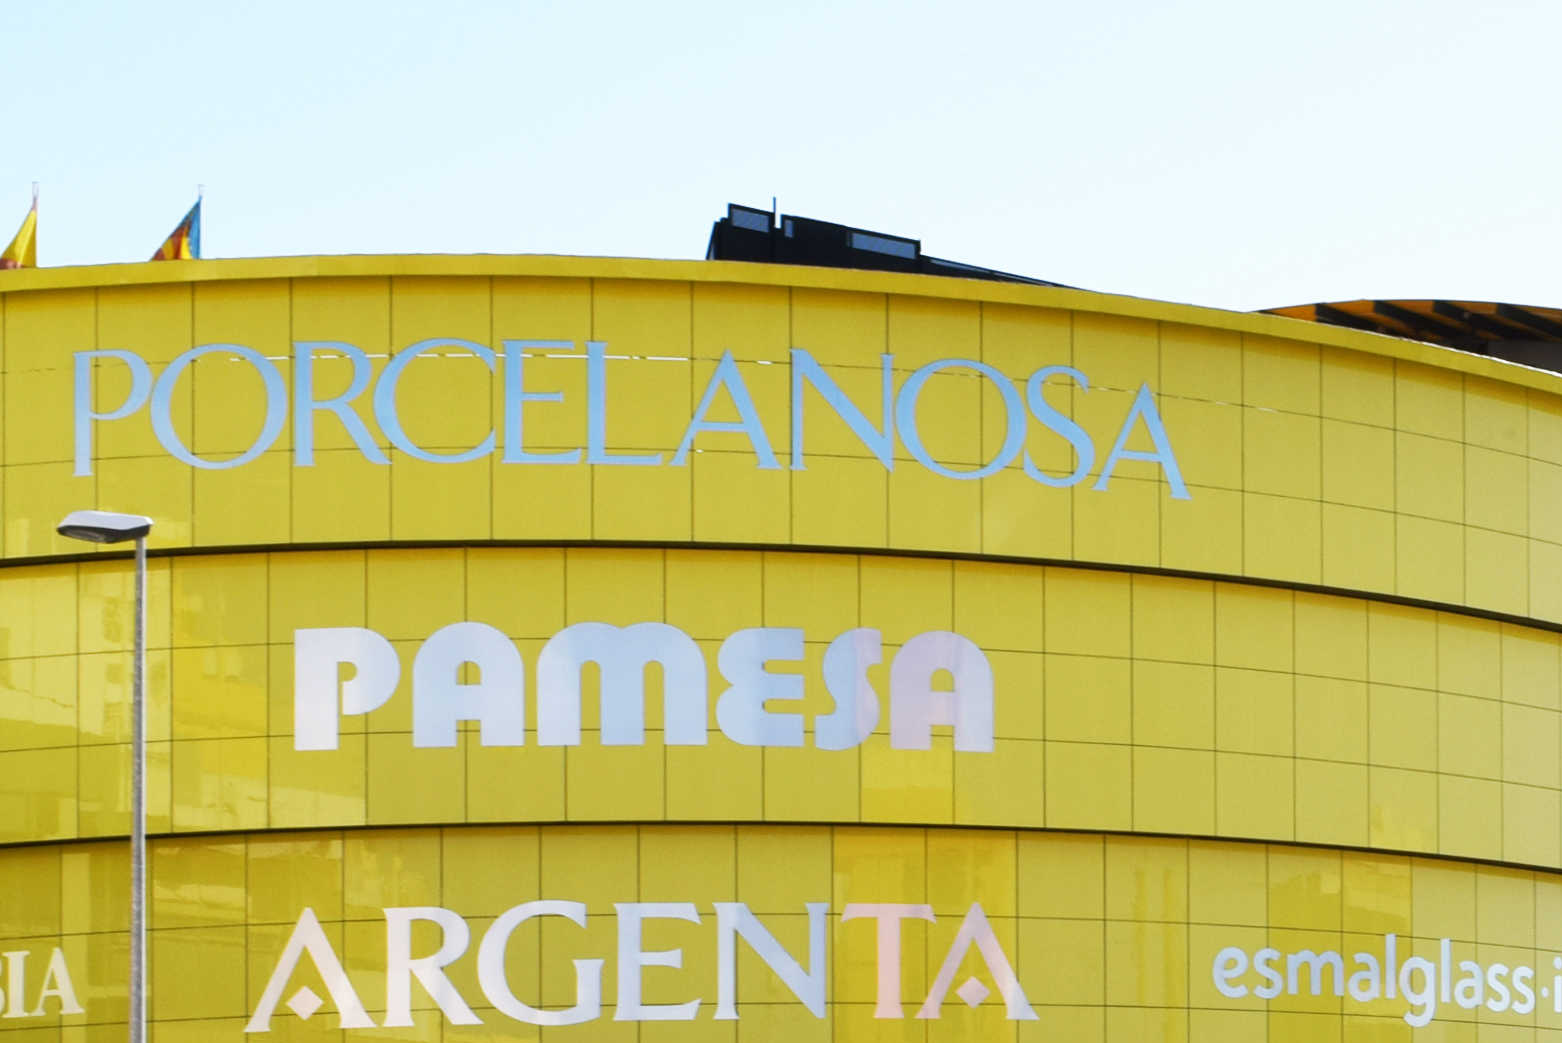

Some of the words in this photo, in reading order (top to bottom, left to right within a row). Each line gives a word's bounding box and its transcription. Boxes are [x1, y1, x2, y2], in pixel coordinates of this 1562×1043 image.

[72, 337, 1192, 500] PORCELANOSA
[294, 621, 995, 753] PAMESA
[0, 946, 85, 1020] IA
[244, 899, 1040, 1033] ARGENTA
